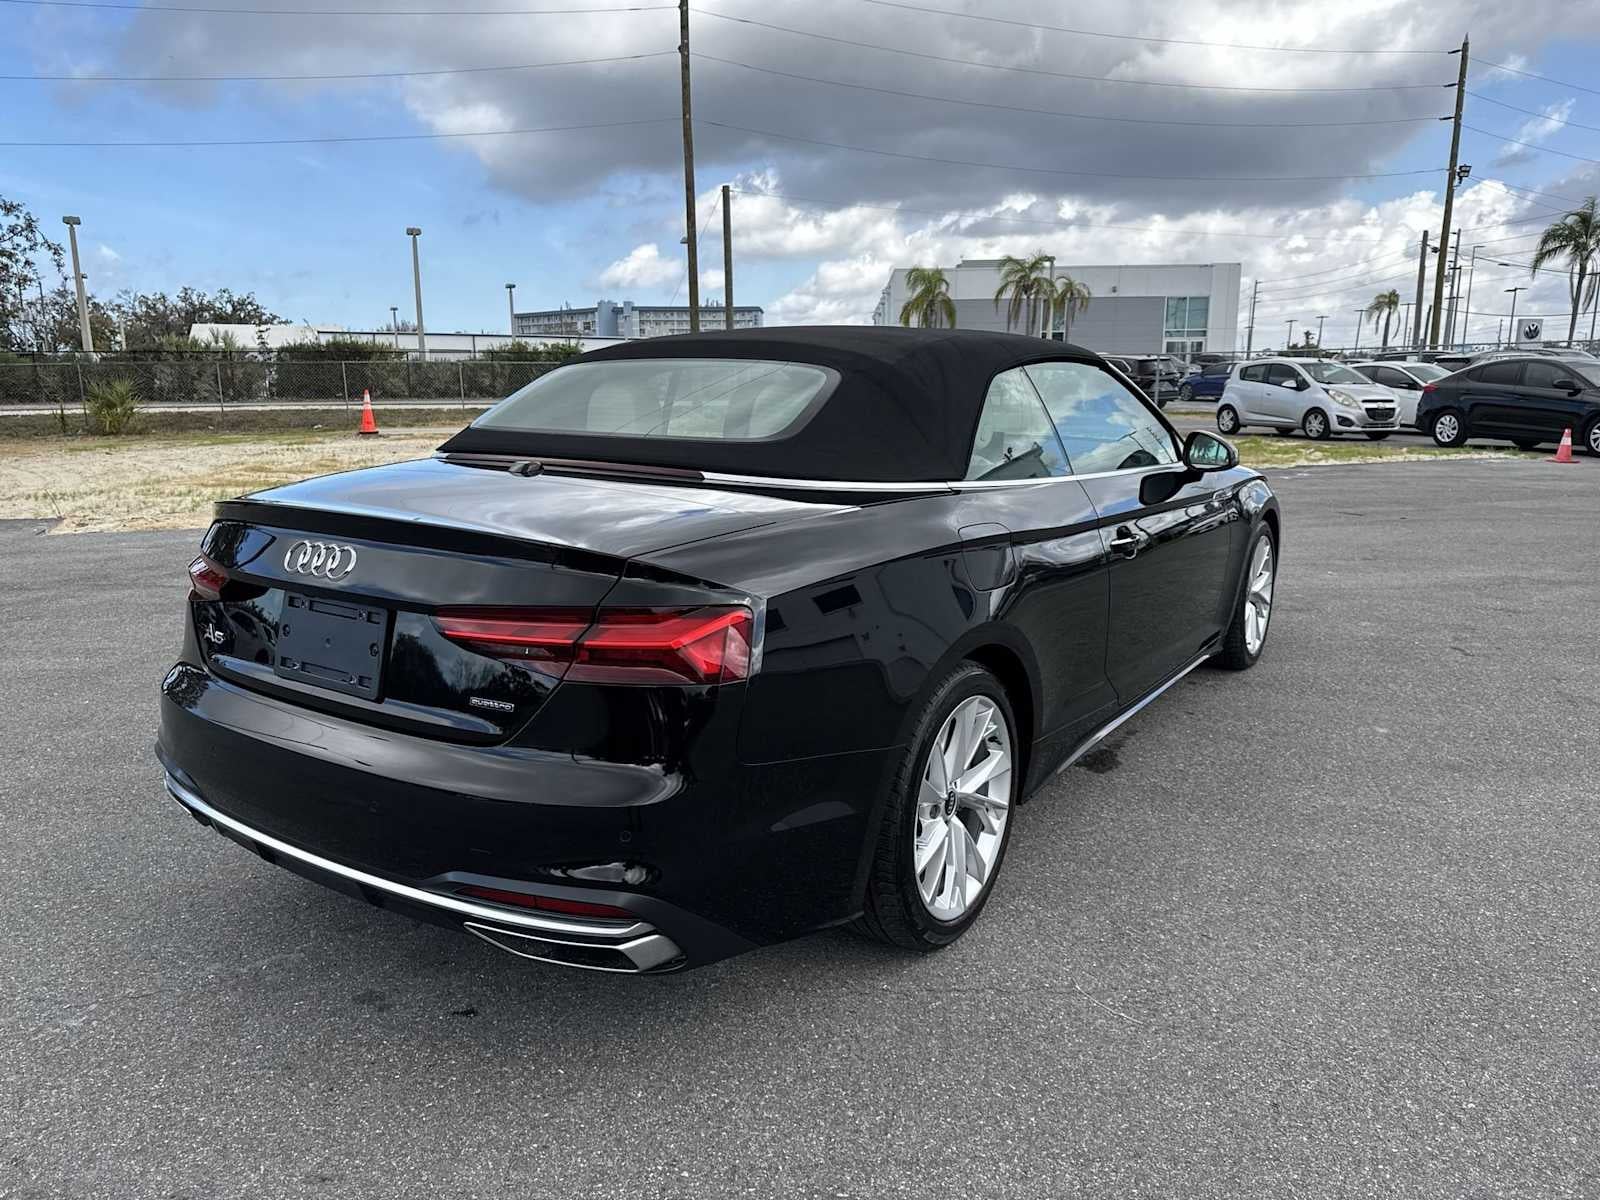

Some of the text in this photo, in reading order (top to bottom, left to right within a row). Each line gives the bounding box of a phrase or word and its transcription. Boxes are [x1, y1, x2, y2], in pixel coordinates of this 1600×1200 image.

[1524, 322, 1540, 339] VW
[204, 623, 225, 644] A5
[470, 697, 513, 711] quattro
